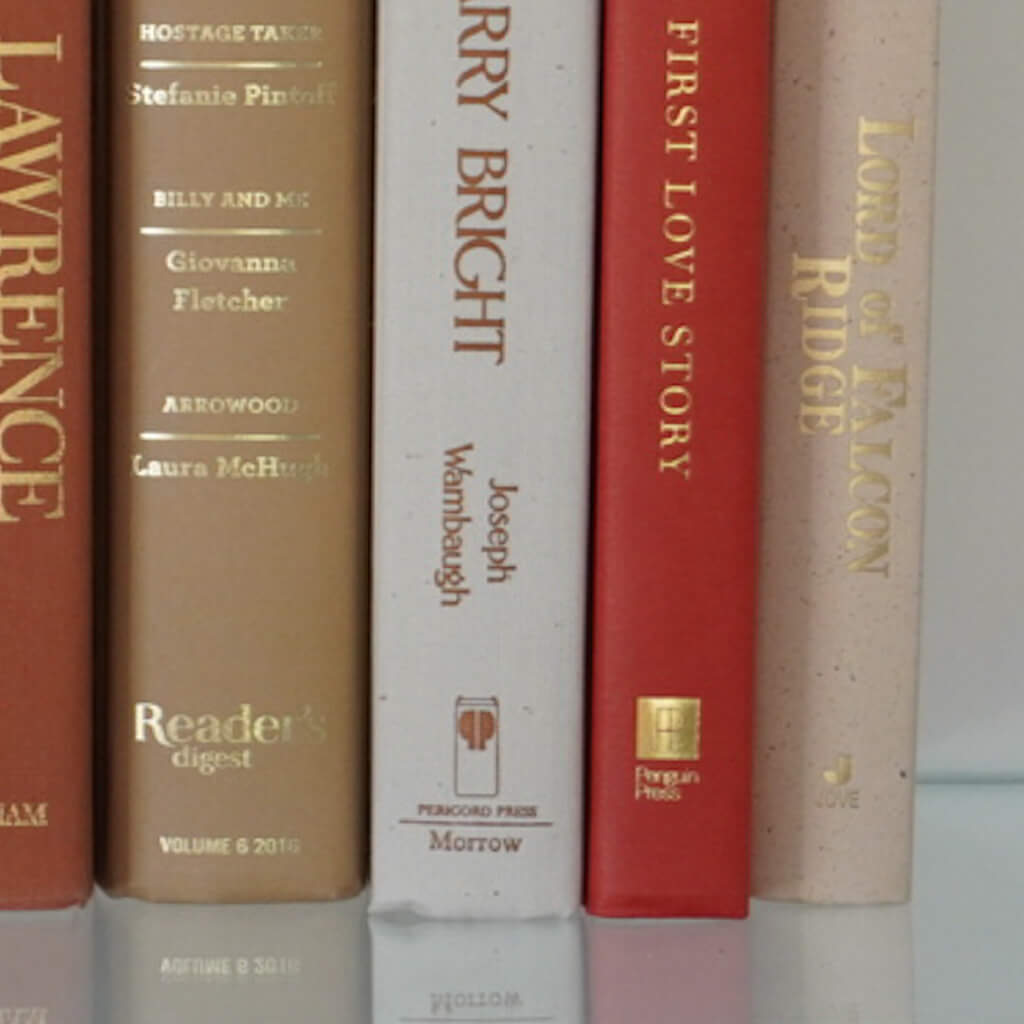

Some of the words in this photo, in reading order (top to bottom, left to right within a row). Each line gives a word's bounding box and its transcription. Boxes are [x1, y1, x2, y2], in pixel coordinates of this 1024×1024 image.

[138, 24, 246, 43] HOSTAGE
[250, 24, 324, 43] TAKER
[129, 82, 238, 106] Stefanie
[664, 19, 700, 162] FIRST
[152, 190, 215, 208] BILLY
[220, 190, 271, 208] AND
[855, 115, 917, 266] LORD
[165, 250, 296, 274] Giovanna
[452, 147, 509, 366] BRIGHT
[661, 180, 698, 306] LOVE
[172, 287, 289, 313] Fletcher
[792, 252, 852, 437] RIDGE
[162, 395, 299, 415] ARROWOOD
[659, 325, 694, 479] STORY
[131, 454, 208, 477] Laura
[847, 364, 908, 579] FALCON
[435, 442, 474, 607] Wambaugh
[482, 477, 518, 585] Joseph
[133, 700, 328, 748] Reader's
[171, 745, 253, 775] digest
[158, 835, 230, 854] VOLUME
[235, 836, 249, 854] 6
[428, 830, 524, 853] Morrow
